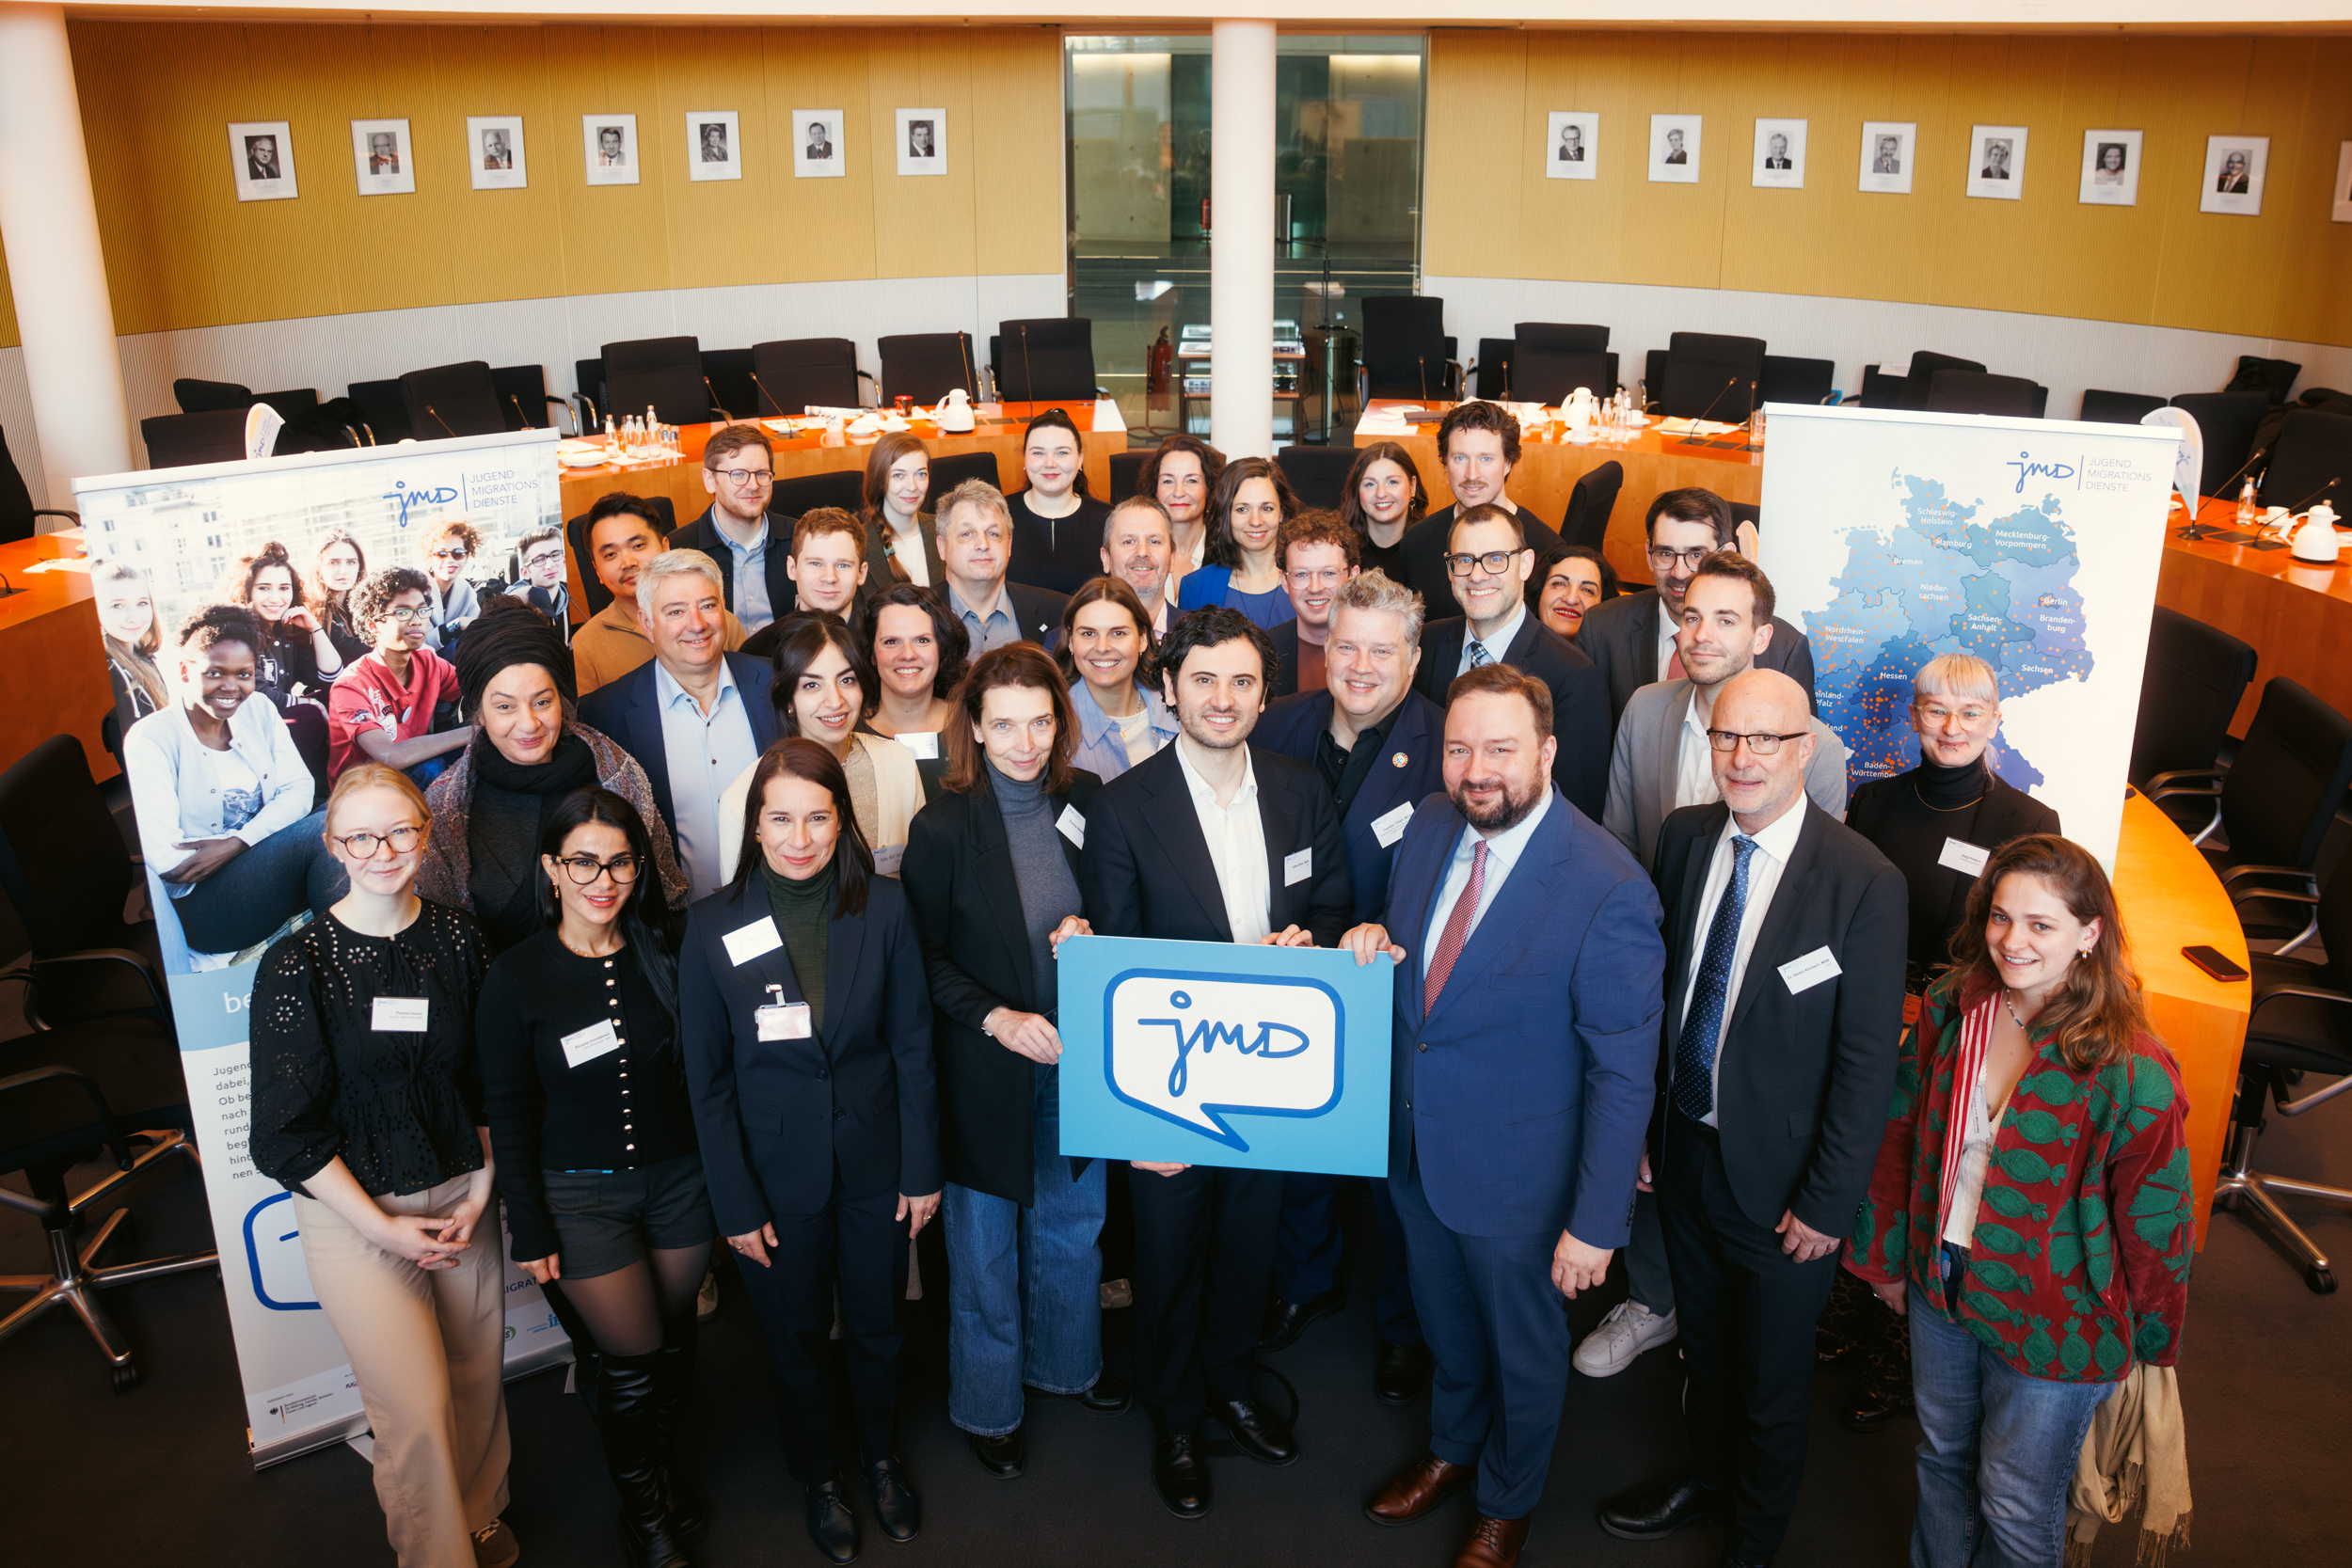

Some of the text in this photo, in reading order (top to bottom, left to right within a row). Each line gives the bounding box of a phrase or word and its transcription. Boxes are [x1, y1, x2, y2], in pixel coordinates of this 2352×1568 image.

[2088, 457, 2132, 468] JUGEND
[470, 469, 515, 483] JUGEND
[2087, 469, 2152, 482] MIGRATIONS
[471, 480, 538, 496] MIGRATIONS
[2086, 481, 2129, 492] DIENSTE
[473, 494, 517, 509] DIENSTE
[1917, 507, 1959, 518] Schleswig-
[1920, 517, 1953, 526] Holstein
[1995, 530, 2051, 542] Mecklenburg-
[1936, 539, 1972, 549] Hamburg
[1994, 539, 2047, 550] Vorpommern
[1893, 557, 1923, 566] Bremen
[1920, 583, 1949, 593] Nieder-
[1918, 592, 1949, 602] sachsen
[2043, 596, 2068, 606] Berlin
[1968, 613, 2003, 623] Sachsen-
[2040, 614, 2076, 625] Branden-
[1825, 626, 1867, 635] Nordrhein-
[1971, 624, 1997, 632] Anhalt
[2047, 624, 2066, 633] burg
[1825, 634, 1864, 643] Westfalen
[2022, 664, 2054, 673] Sachsen
[1880, 672, 1908, 680] Hessen
[1815, 690, 1845, 699] einland-
[1864, 761, 1891, 769] Baden-
[1851, 766, 1900, 779] Württember
[223, 991, 251, 1013] be
[215, 1077, 250, 1091] dabei,
[218, 1093, 251, 1105] Ob be
[221, 1108, 247, 1120] nach
[227, 1140, 248, 1150] beg
[230, 1153, 252, 1164] hint
[232, 1169, 253, 1180] nen
[505, 1276, 537, 1293] IGRAT
